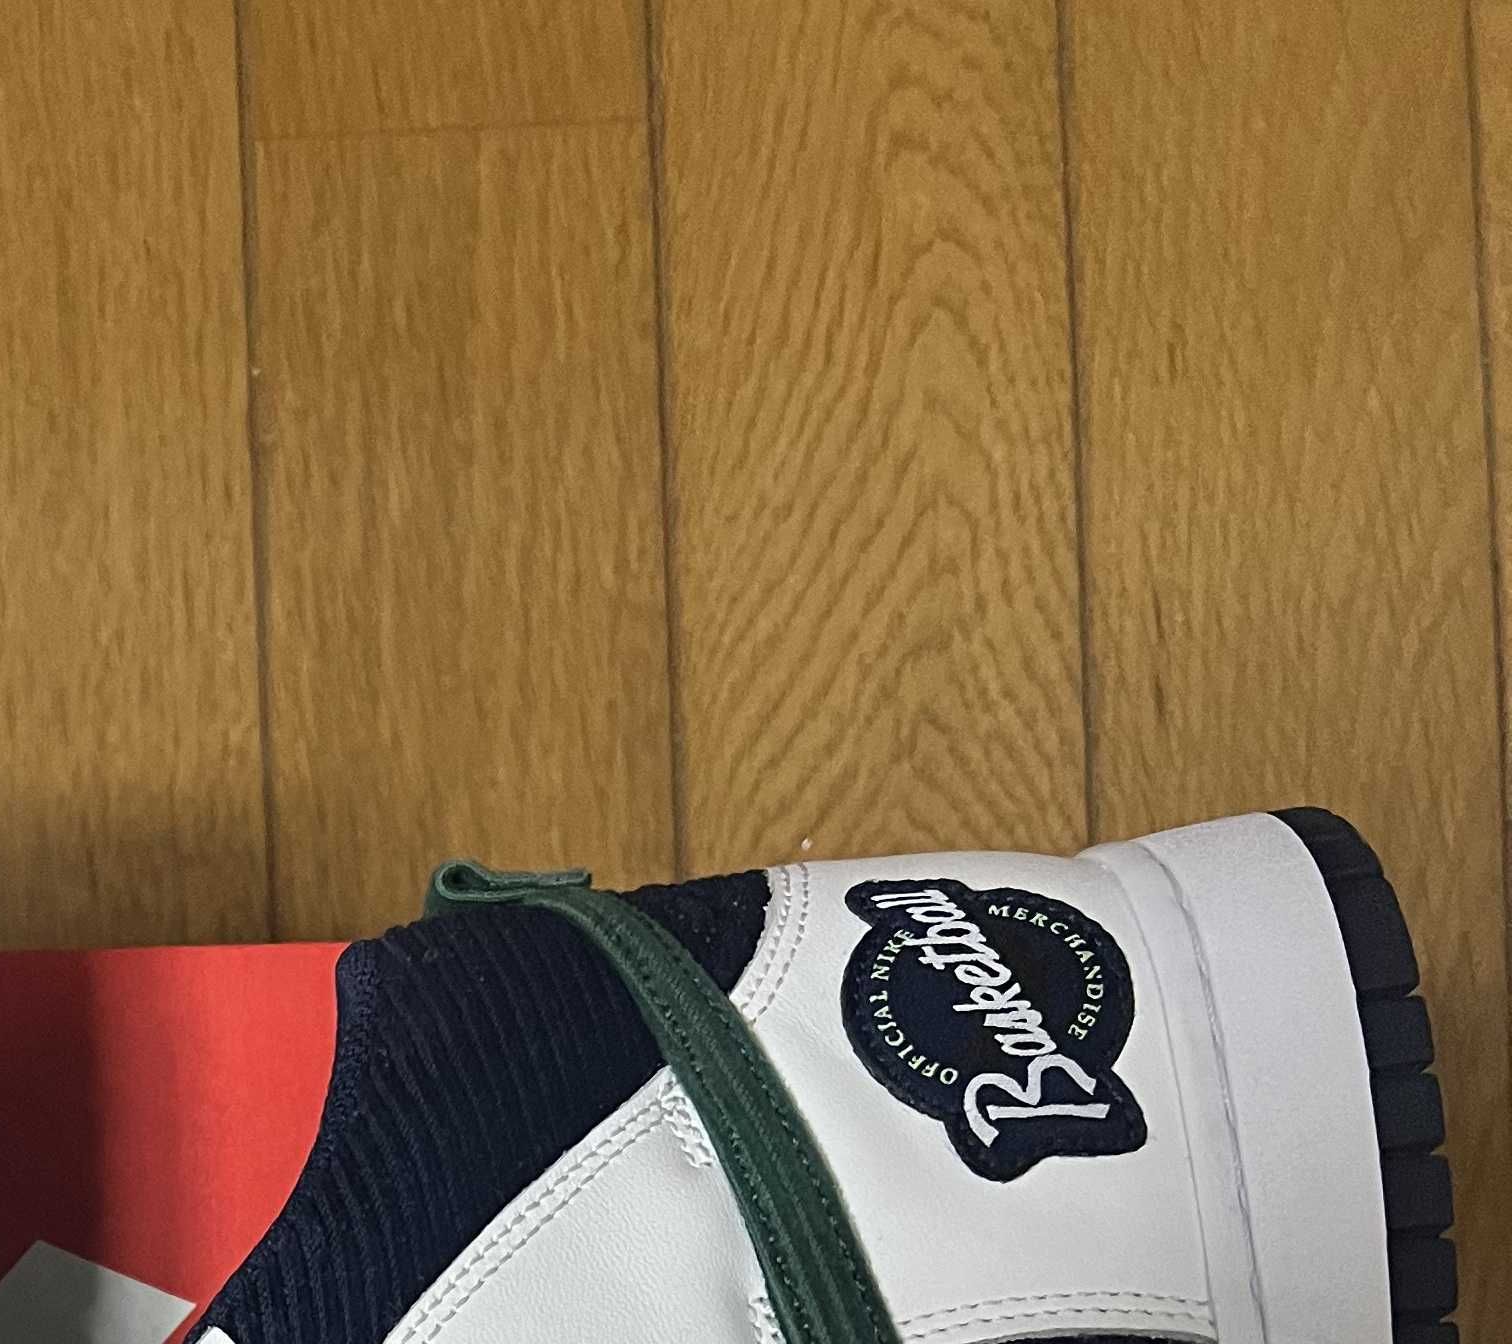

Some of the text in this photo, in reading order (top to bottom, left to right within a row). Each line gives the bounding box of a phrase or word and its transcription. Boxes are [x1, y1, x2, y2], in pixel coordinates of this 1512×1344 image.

[869, 929, 959, 1085] OFFICIAL NIKE
[871, 889, 1110, 1147] Basketball
[988, 904, 1105, 1040] MERCHANDISE
